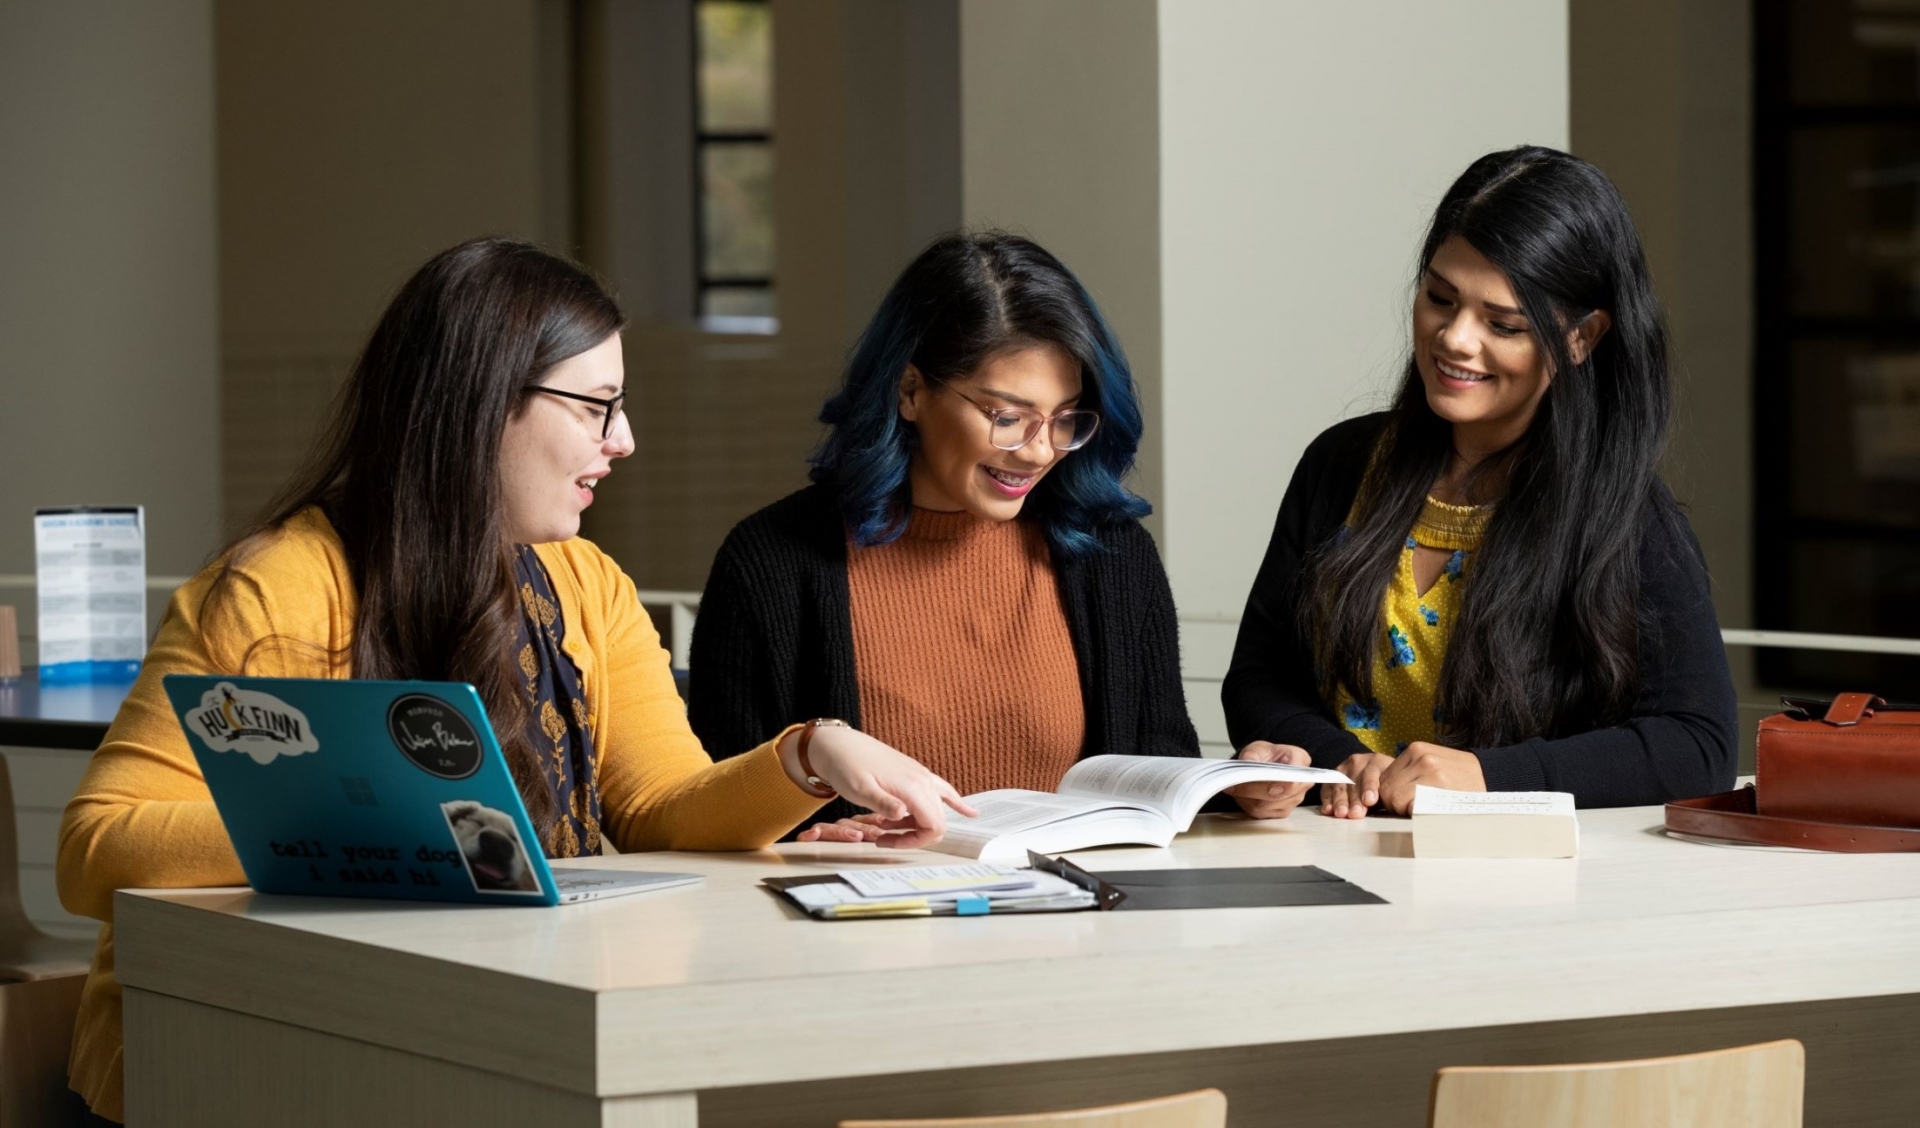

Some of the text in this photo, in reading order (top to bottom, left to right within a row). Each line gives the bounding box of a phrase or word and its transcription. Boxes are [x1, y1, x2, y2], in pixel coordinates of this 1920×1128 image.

[250, 705, 304, 742] FINN
[269, 839, 463, 869] tell your dog
[308, 862, 441, 887] i said hi
